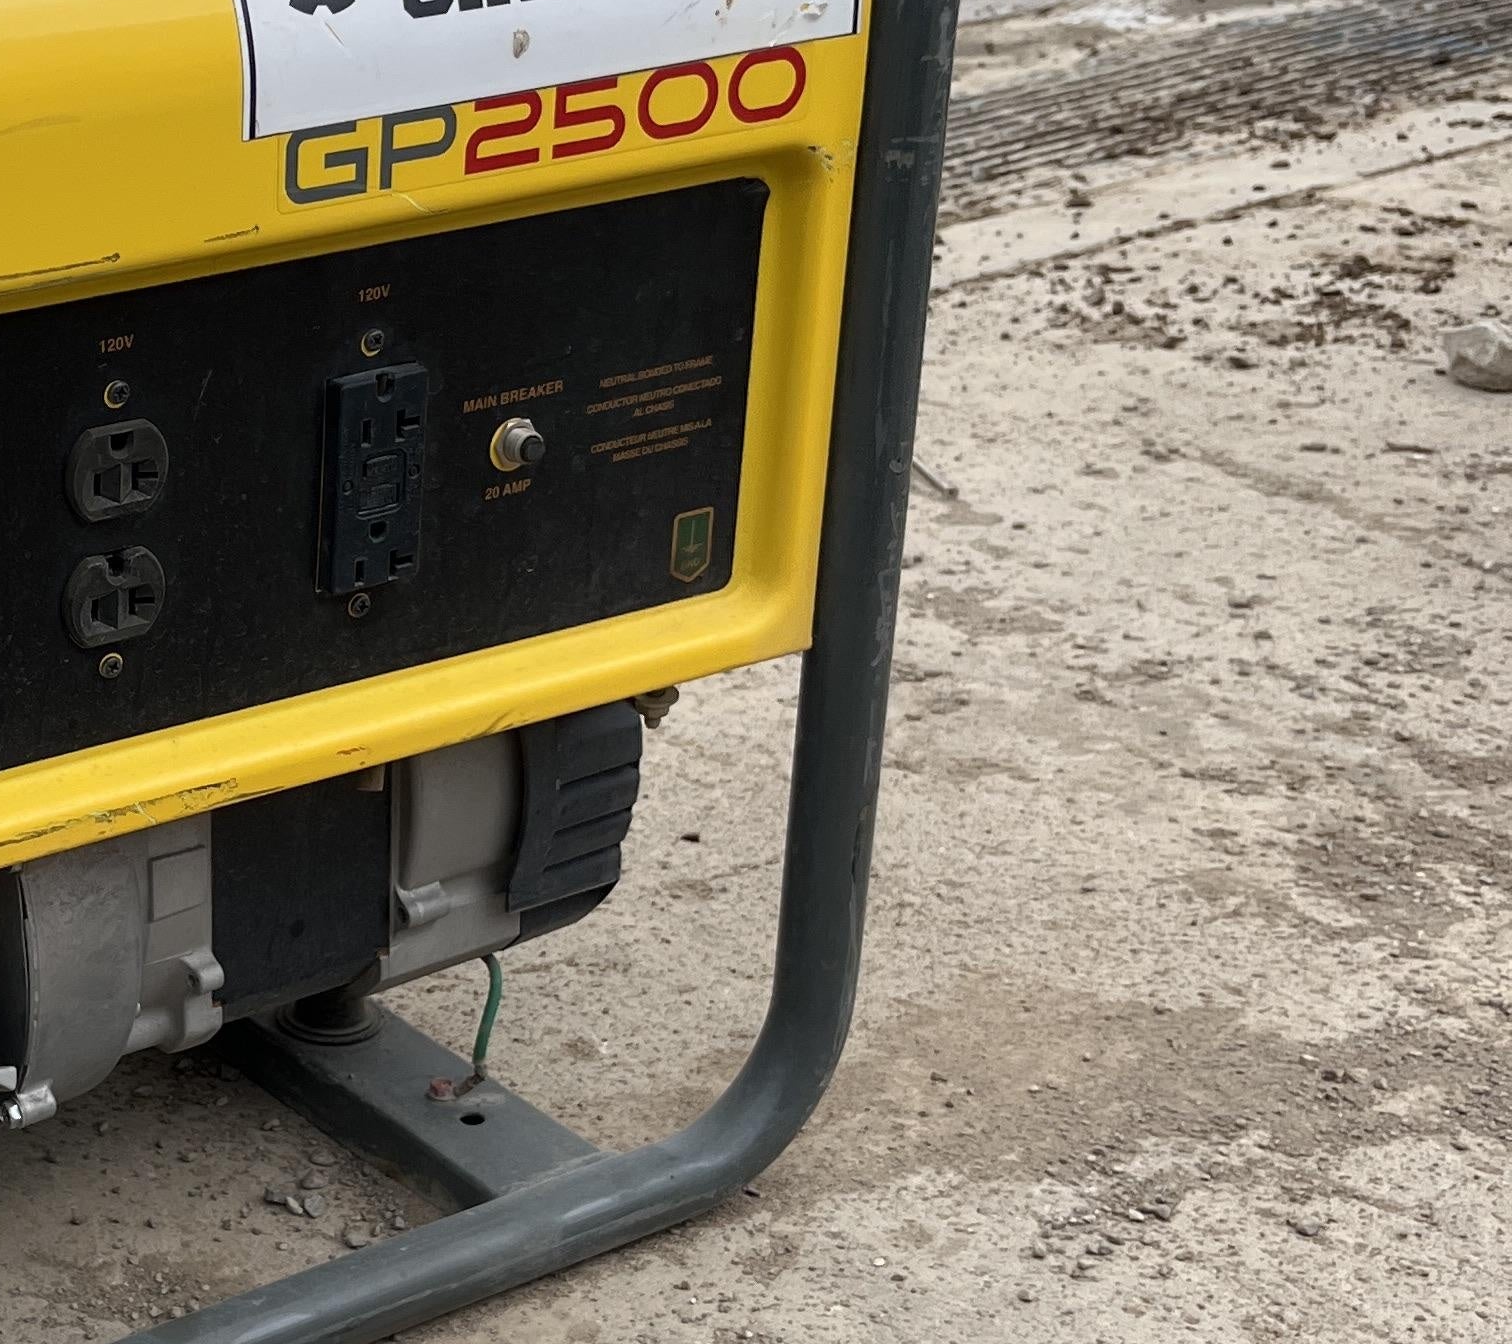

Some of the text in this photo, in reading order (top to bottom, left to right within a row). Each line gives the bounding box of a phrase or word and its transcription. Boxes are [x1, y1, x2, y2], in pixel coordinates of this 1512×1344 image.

[285, 44, 807, 205] GP2500
[358, 283, 392, 303] 120V
[98, 333, 135, 354] 120V
[463, 380, 565, 414] MAIN BREAKER
[485, 478, 532, 501] 20 AMP
